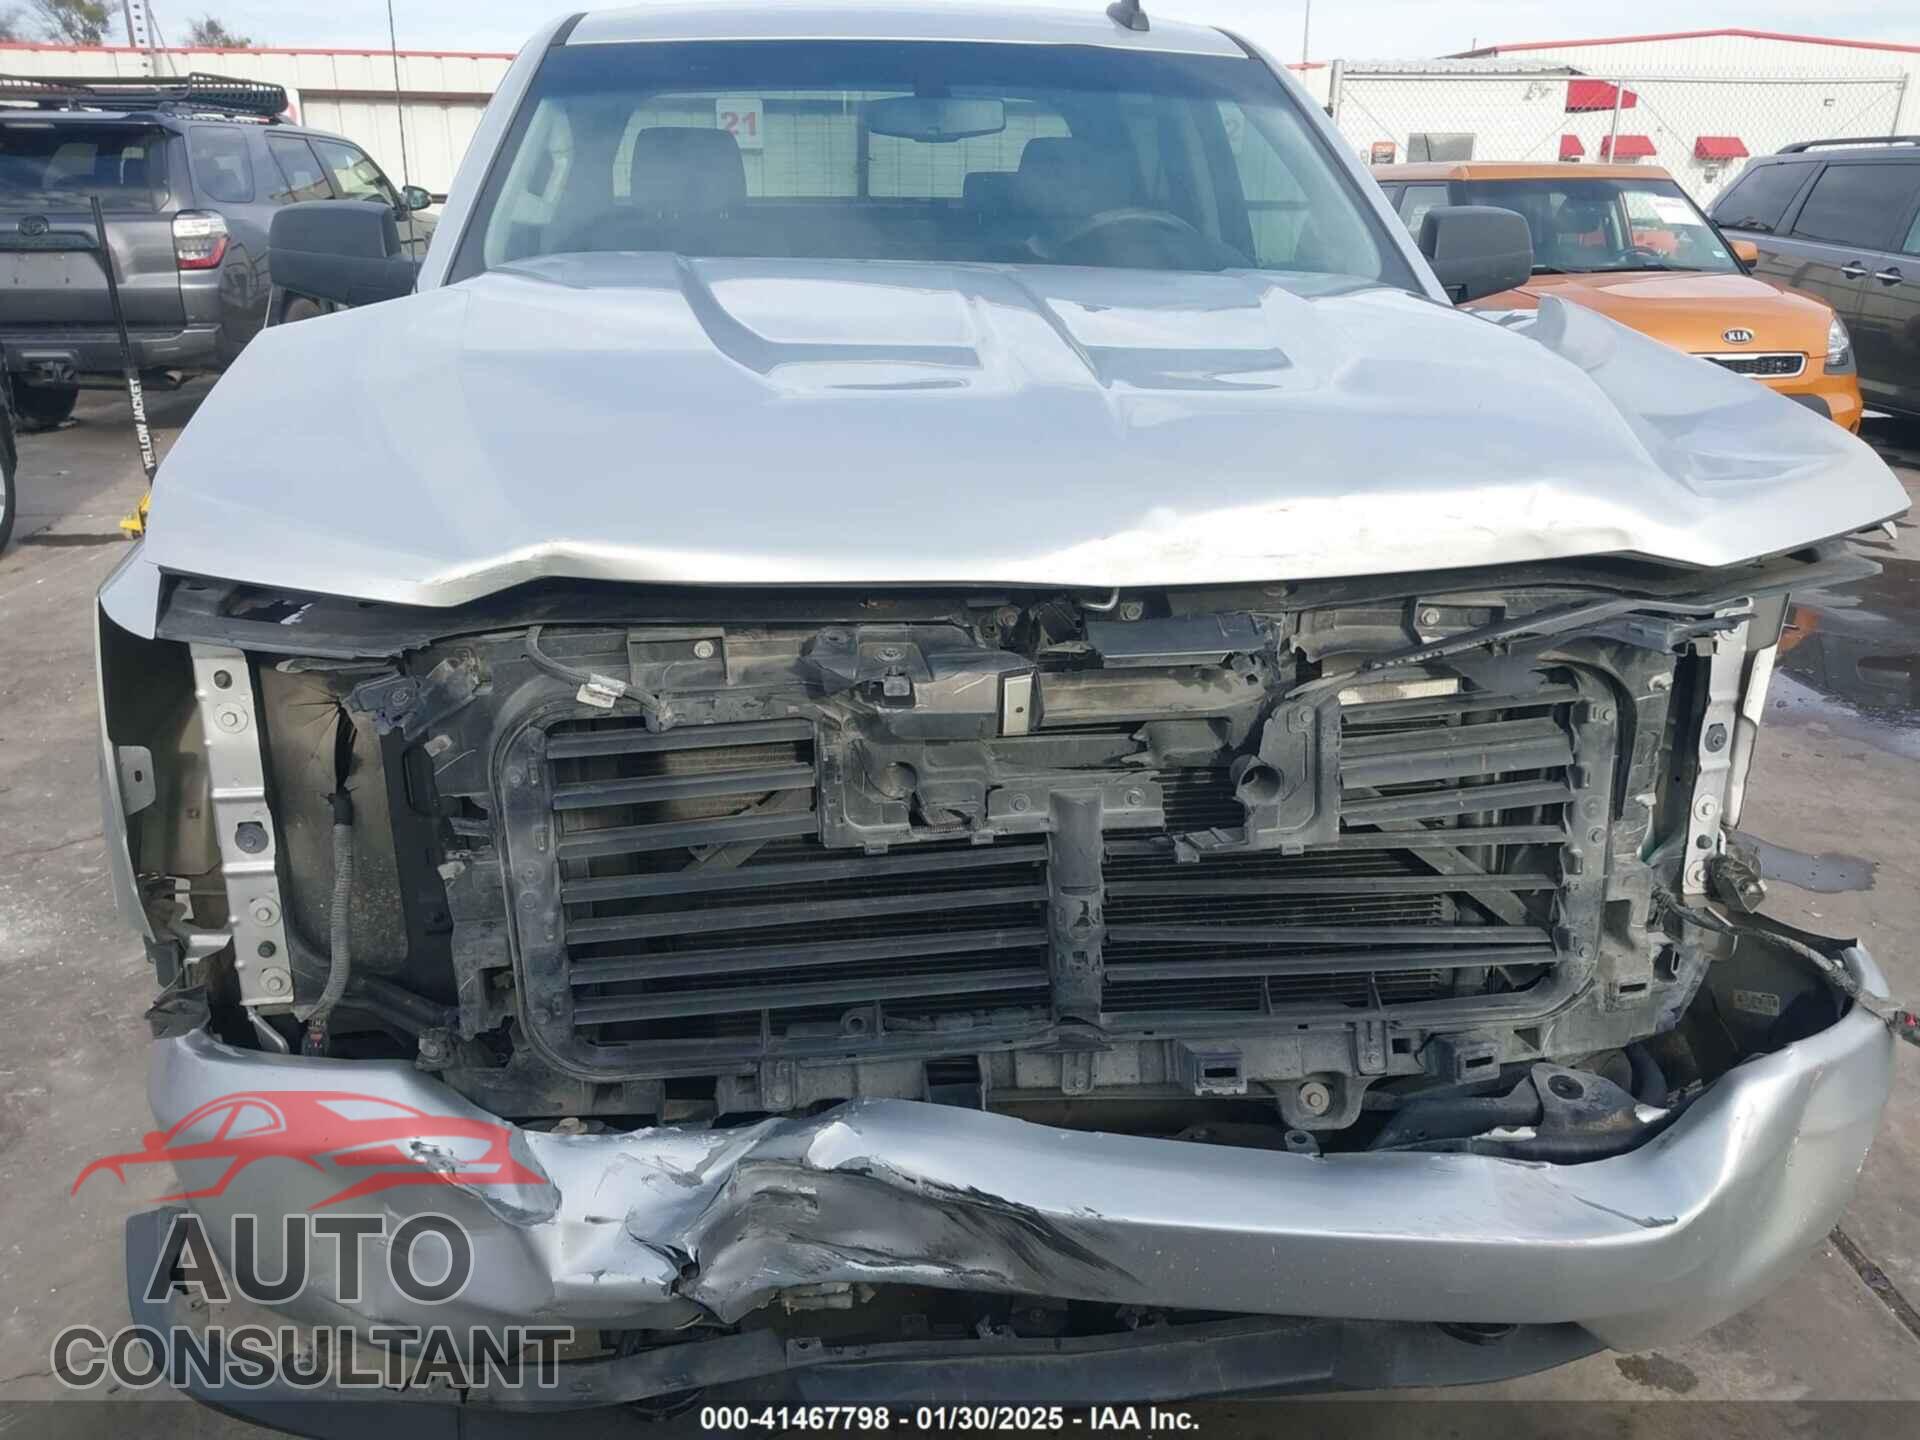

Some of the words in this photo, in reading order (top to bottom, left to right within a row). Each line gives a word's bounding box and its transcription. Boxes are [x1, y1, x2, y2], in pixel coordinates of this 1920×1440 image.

[720, 111, 756, 137] 21
[1728, 331, 1750, 341] KIA
[129, 378, 146, 422] JACKET
[136, 423, 155, 469] YELLOW
